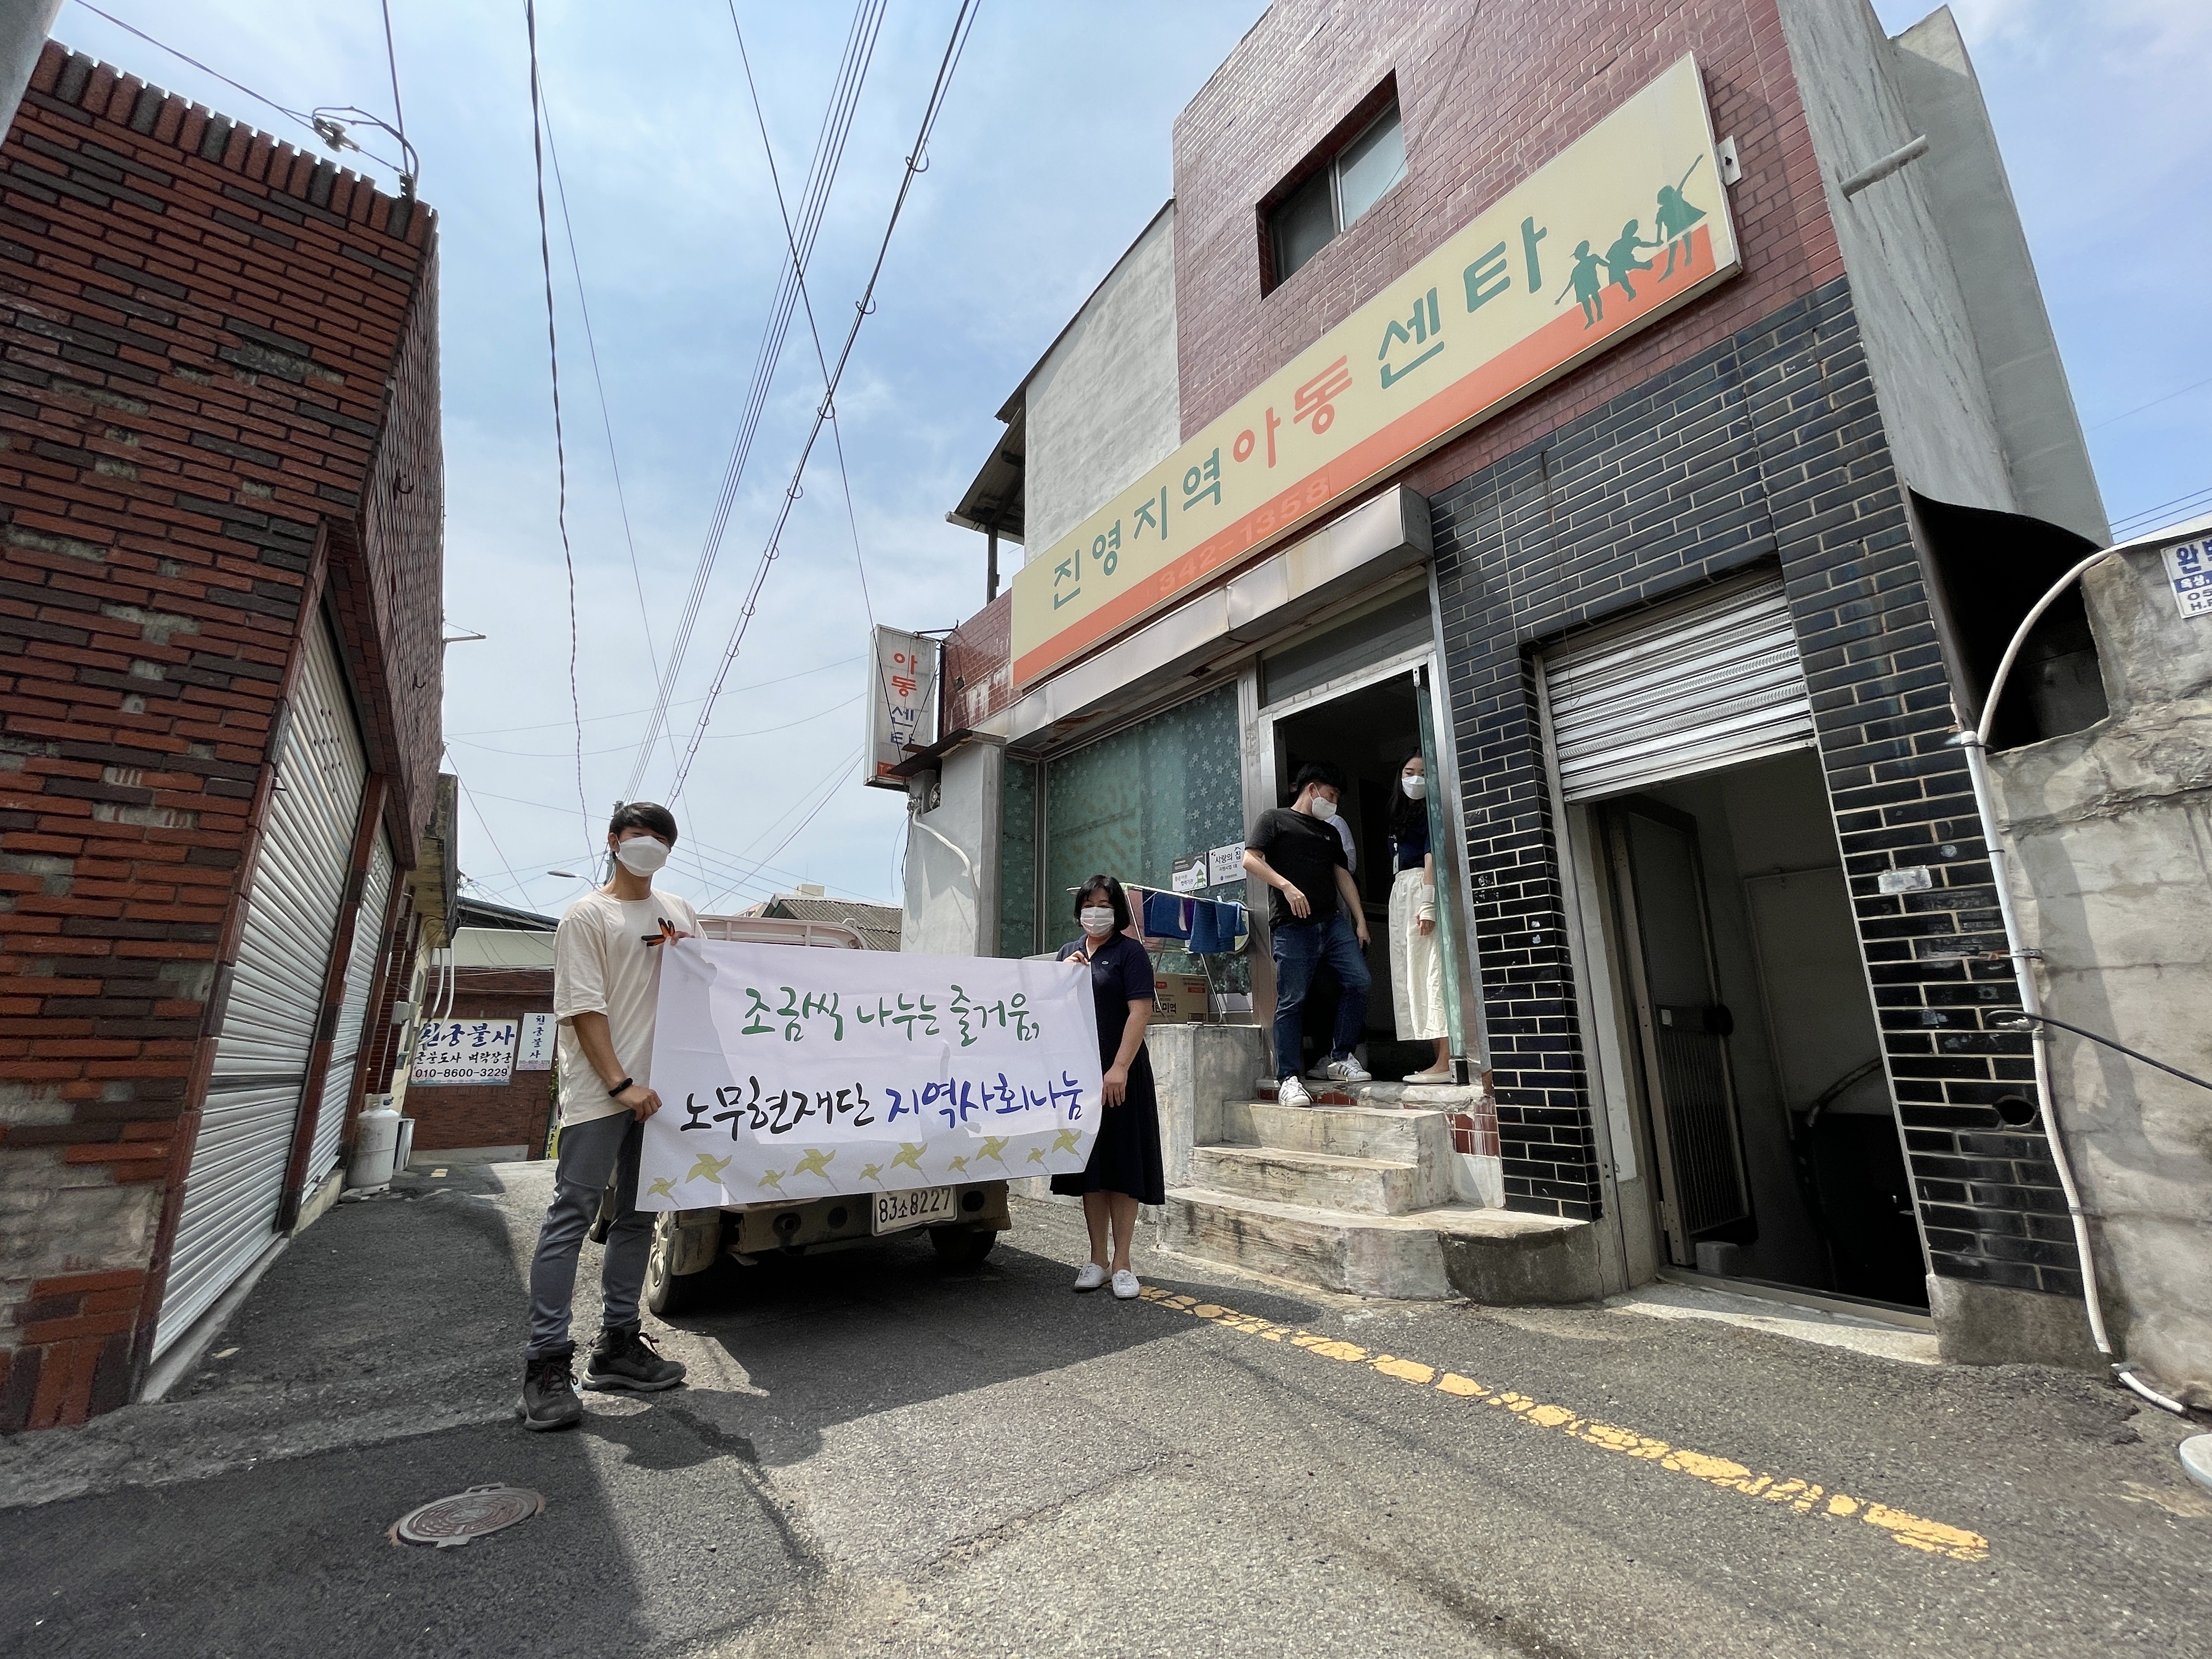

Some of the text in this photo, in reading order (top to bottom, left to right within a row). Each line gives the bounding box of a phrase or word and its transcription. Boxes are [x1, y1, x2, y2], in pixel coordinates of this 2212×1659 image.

[1053, 216, 1547, 610] 진영지역아동센타
[1159, 477, 1330, 593] 342-1358
[1215, 853, 1233, 864] 사랑의
[1234, 847, 1242, 860] 집
[742, 985, 1040, 1046] 조금씩 나누는 즐거움,
[415, 1068, 507, 1078] 010-8600-3229
[469, 1051, 512, 1064] 벼락장군
[680, 1070, 1084, 1141] 노무현재단 지역사회나눔
